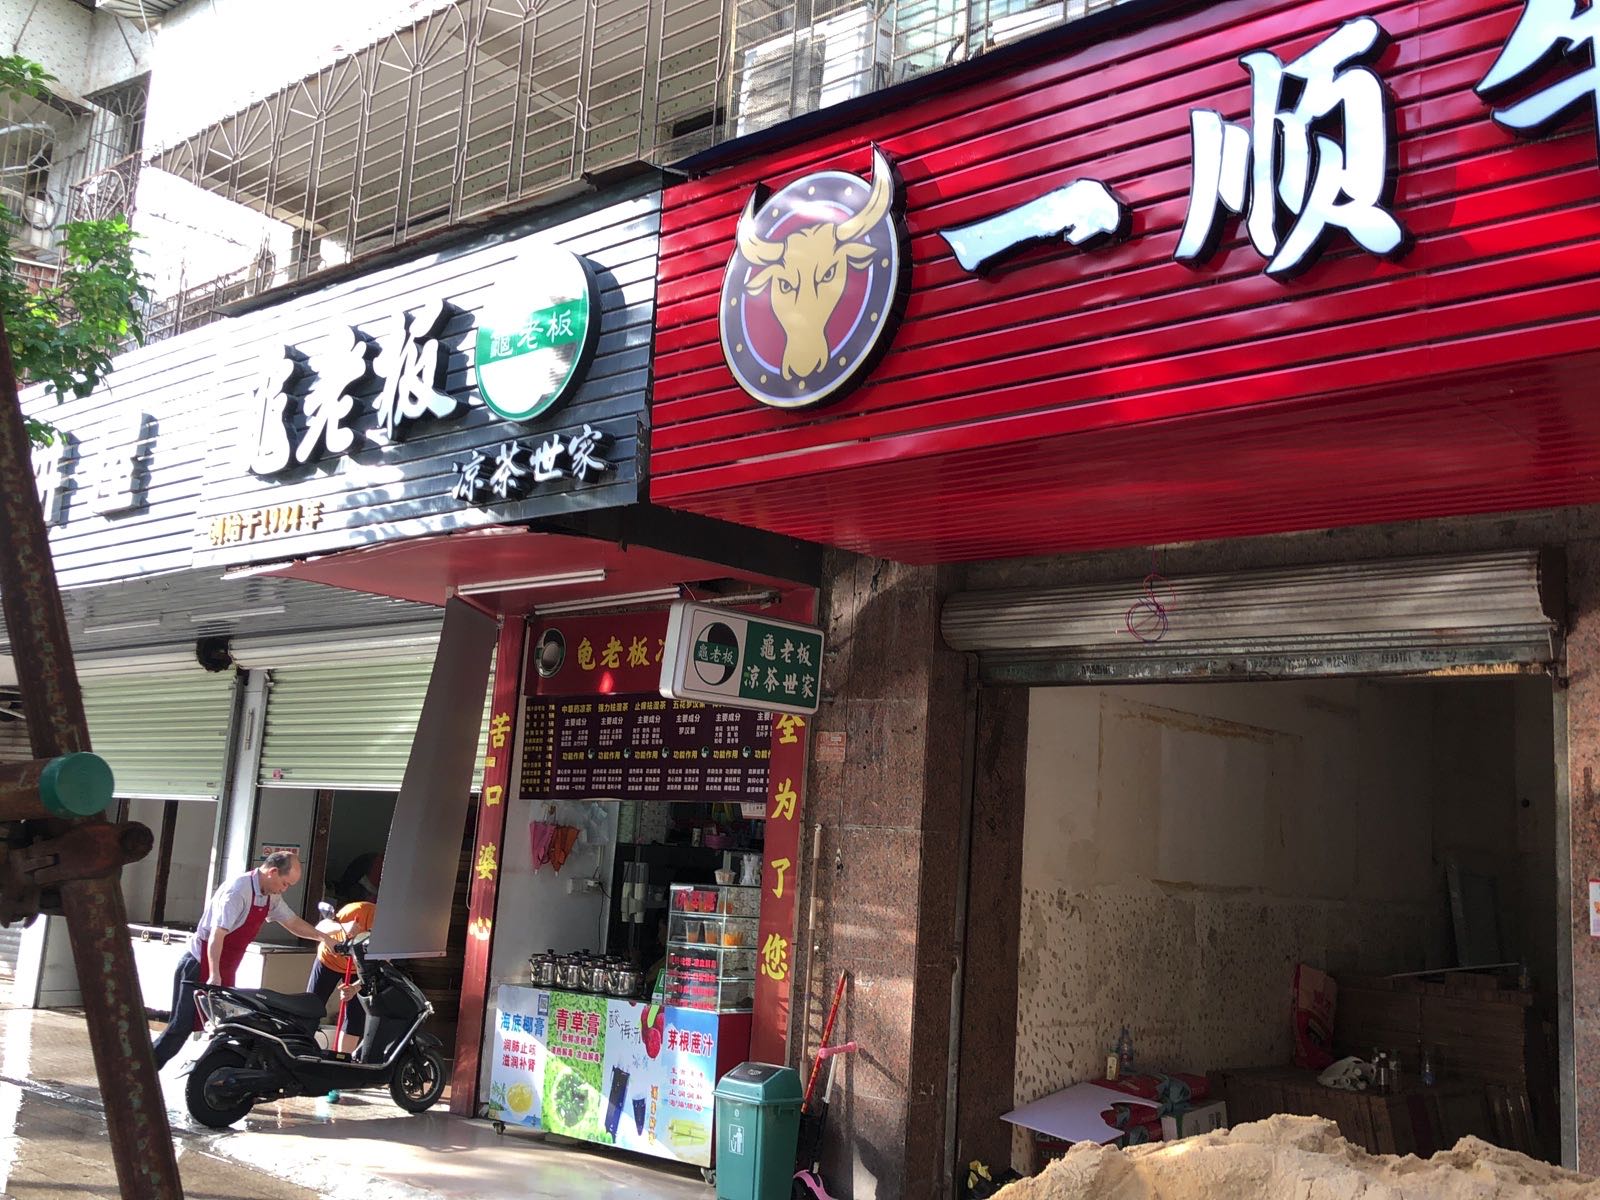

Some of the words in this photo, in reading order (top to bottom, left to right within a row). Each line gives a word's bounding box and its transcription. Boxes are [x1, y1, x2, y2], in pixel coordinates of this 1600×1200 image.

[452, 424, 607, 501] 凉茶世家
[760, 633, 814, 667] 龜老板
[743, 664, 815, 699] 凉茶世家
[501, 1011, 545, 1038] 海底椰膏
[556, 1008, 600, 1036] 青草膏
